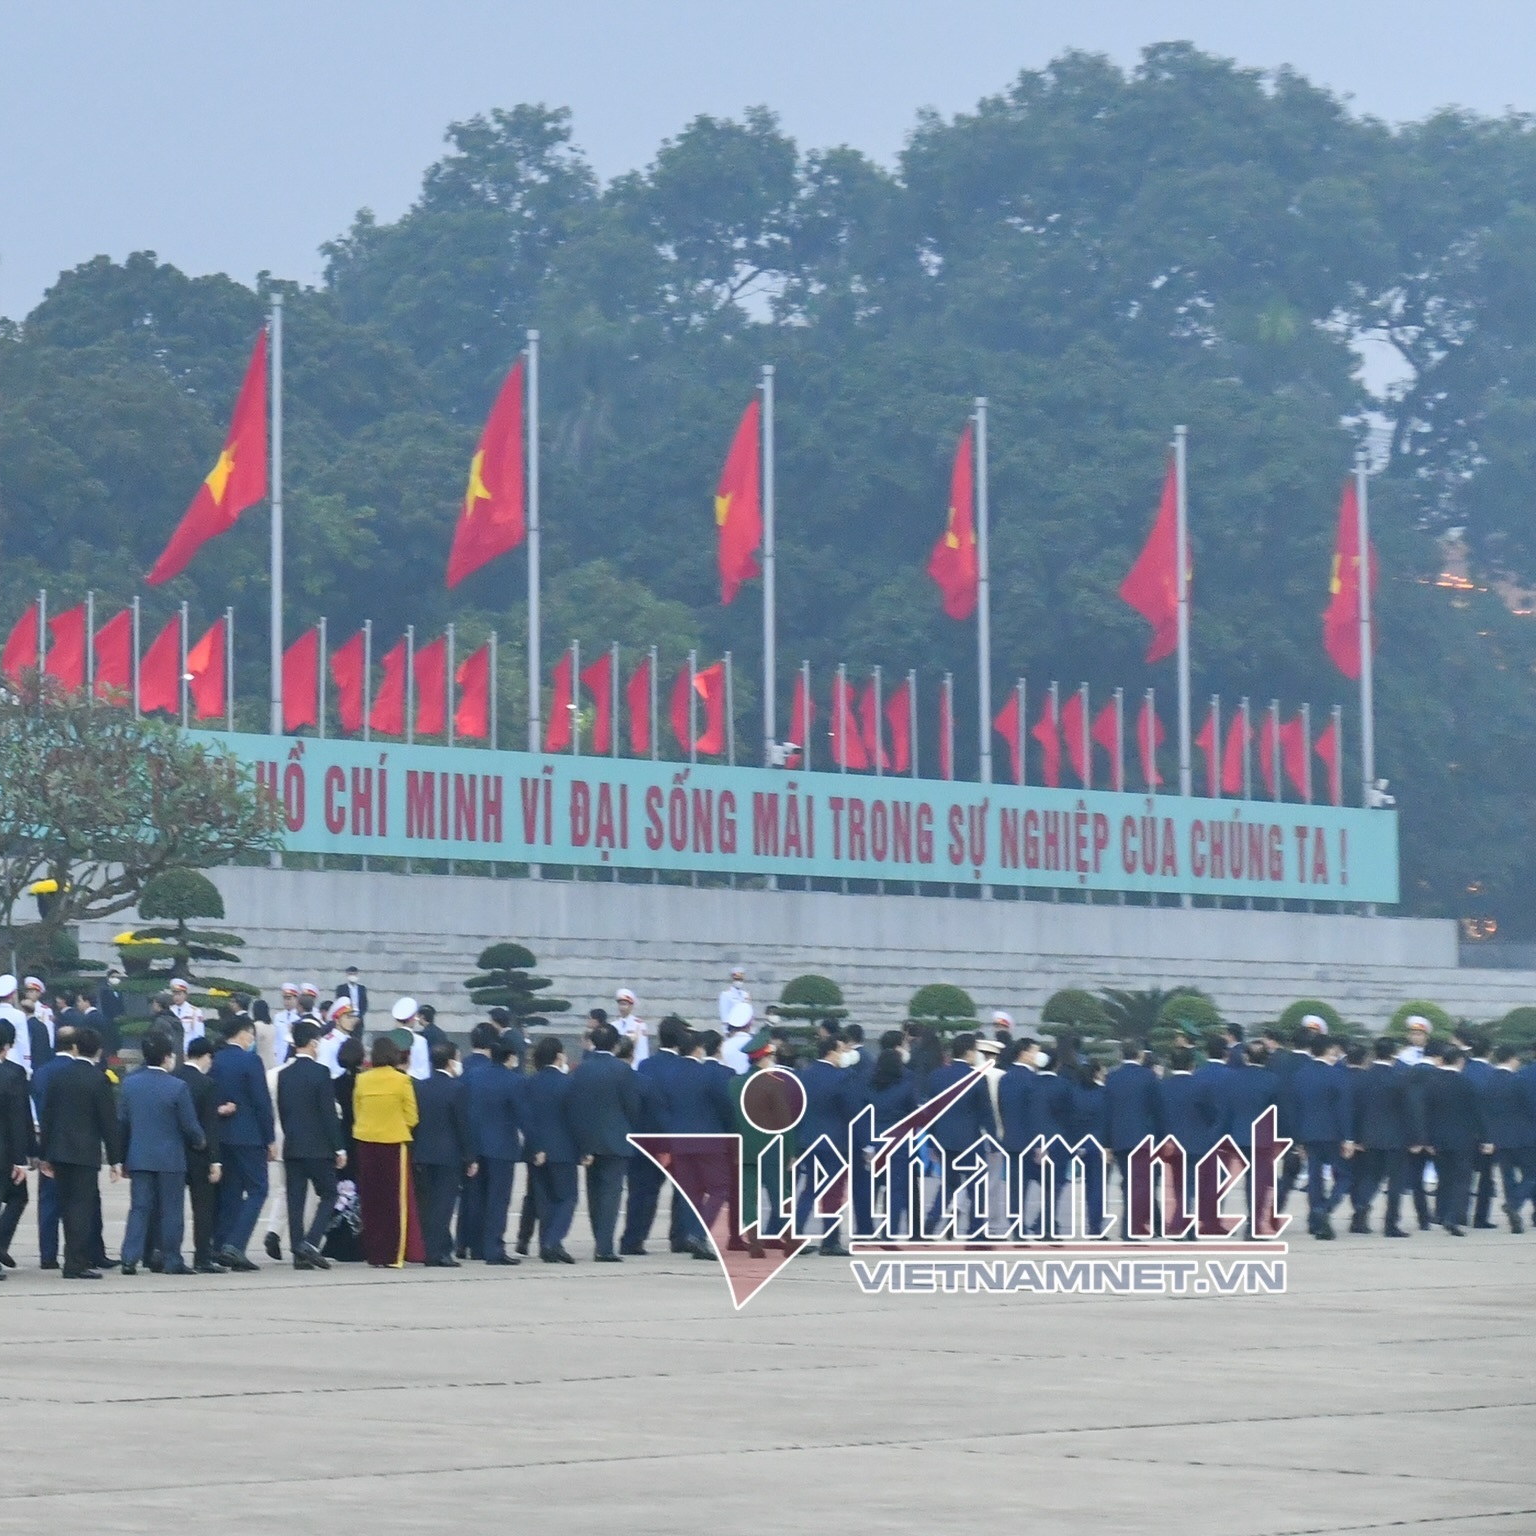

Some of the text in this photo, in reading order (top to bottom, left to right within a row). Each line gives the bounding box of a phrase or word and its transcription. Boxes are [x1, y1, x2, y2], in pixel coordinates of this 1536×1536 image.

[256, 740, 306, 833] HỒ
[324, 752, 388, 838] CHÍ
[405, 770, 503, 843] MINH
[520, 765, 555, 846] VĨ
[569, 780, 629, 862] ĐẠI
[644, 767, 737, 855] SỐNG
[752, 781, 816, 859] MÃI
[829, 796, 934, 864] TRONG
[948, 796, 990, 880] SỰ
[1000, 798, 1110, 884] NGHIỆP
[1121, 797, 1178, 877] CỦA
[1191, 807, 1284, 882] CHÚNG
[1294, 825, 1329, 885] TA
